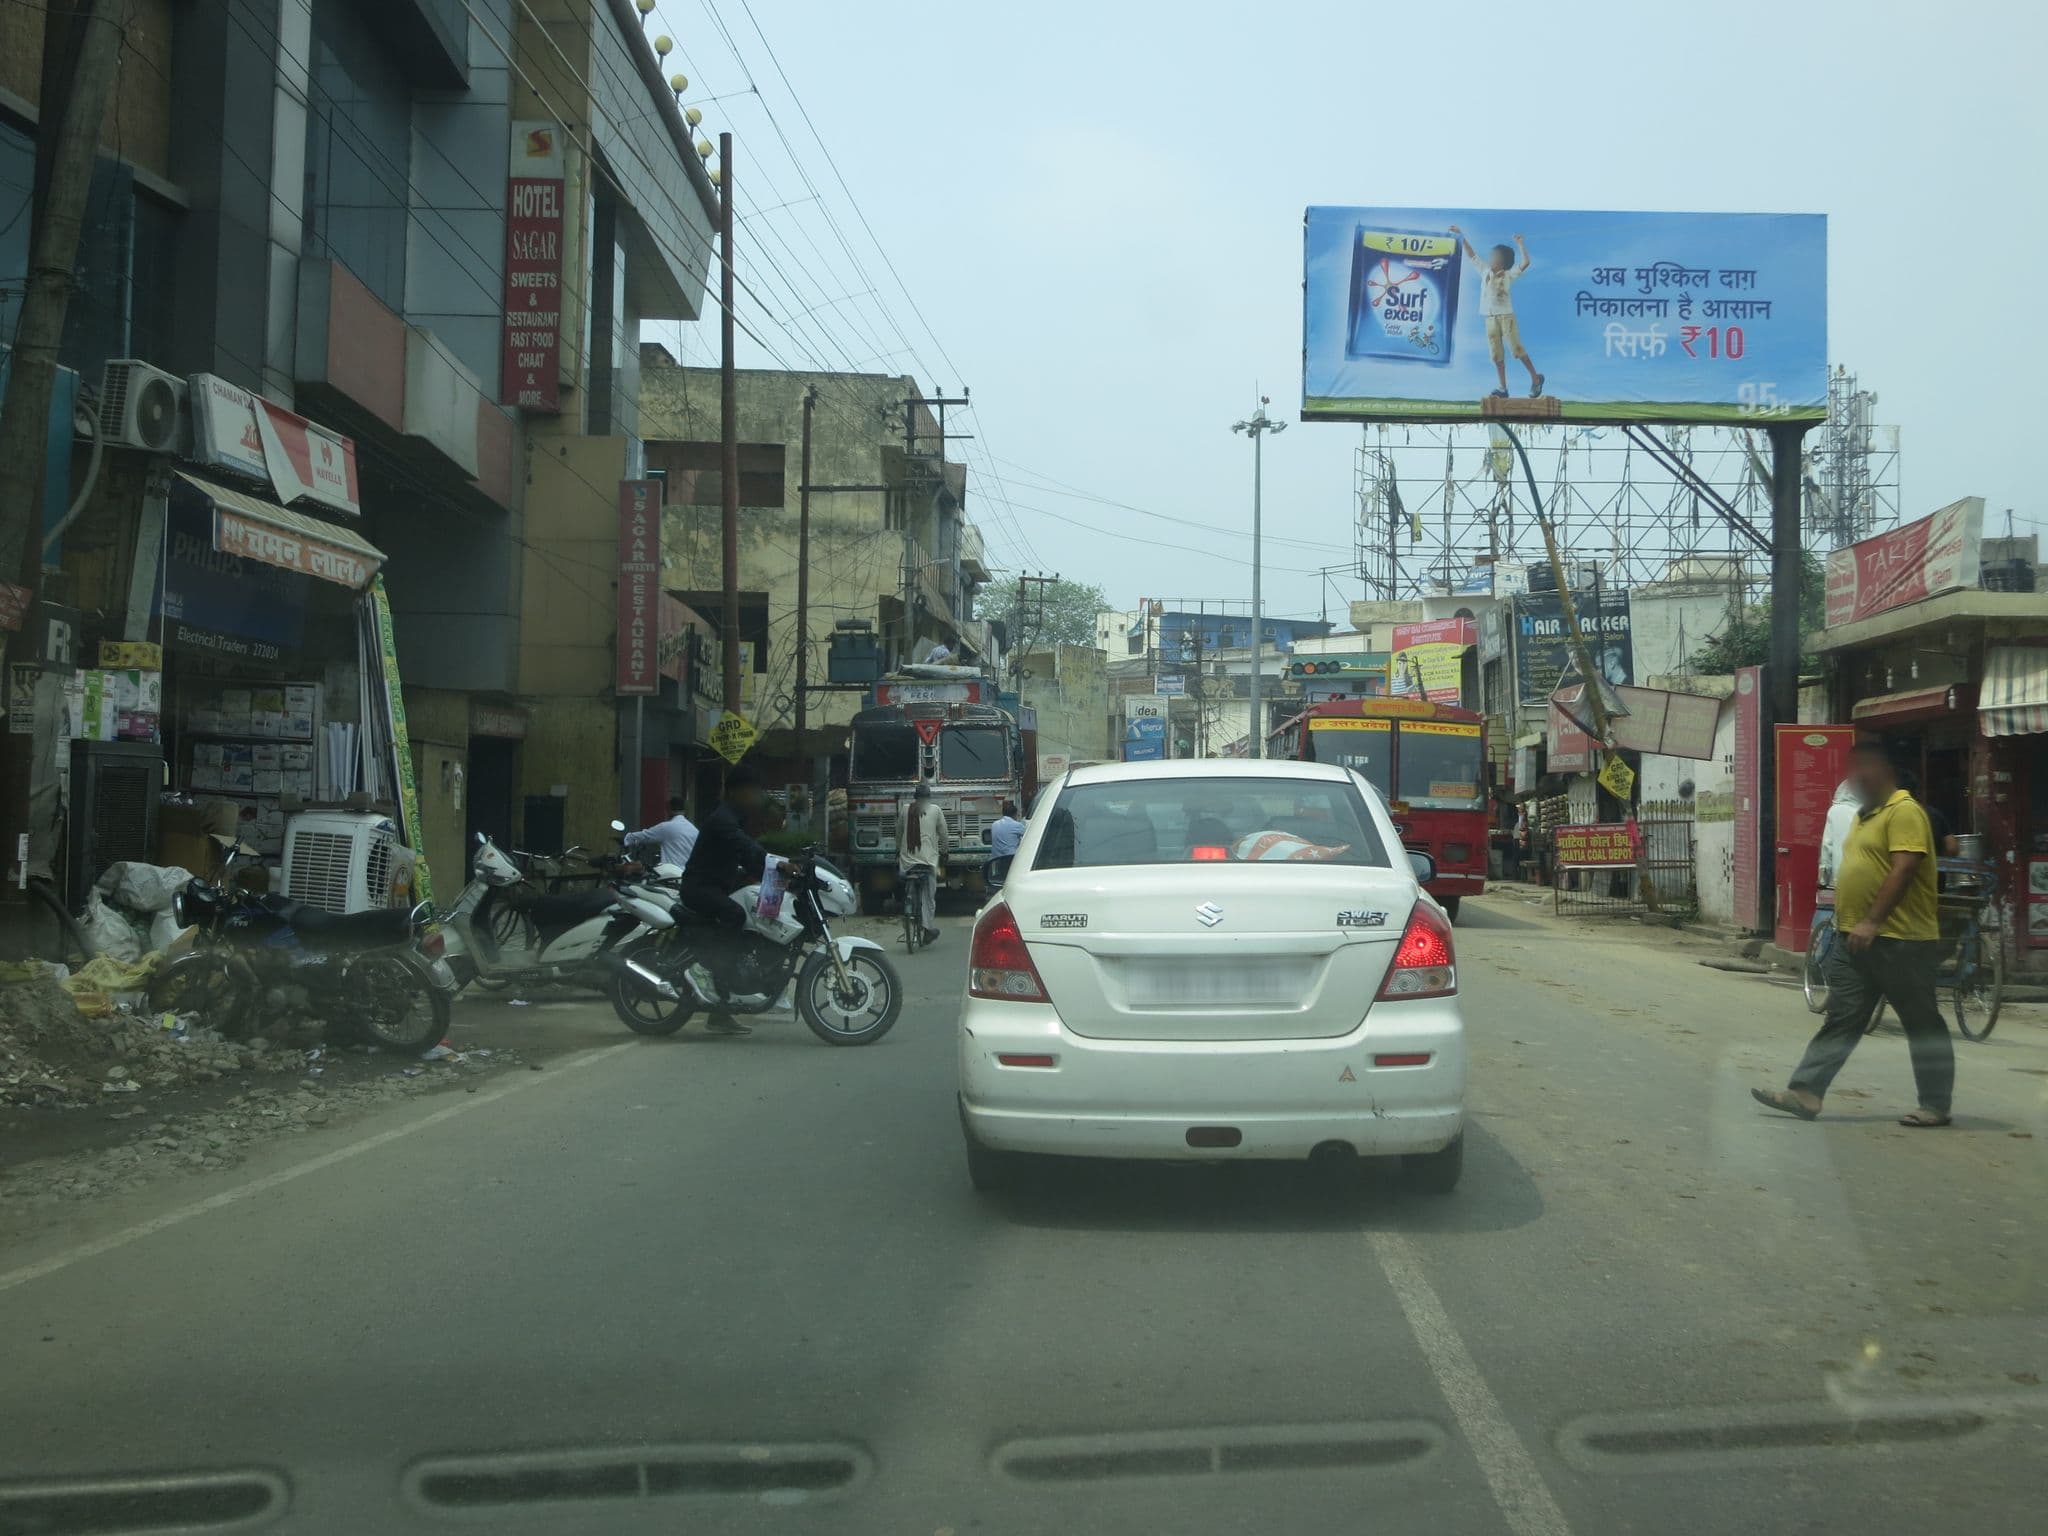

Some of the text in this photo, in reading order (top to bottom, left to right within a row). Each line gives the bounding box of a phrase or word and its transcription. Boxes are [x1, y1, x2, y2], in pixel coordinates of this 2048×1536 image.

[513, 185, 559, 218] HOTEL
[513, 231, 556, 260] SAGAR
[511, 273, 557, 287] SWEETS
[1592, 267, 1627, 287] अब
[1635, 261, 1711, 294] मुश्किल
[529, 293, 538, 306] &
[1386, 286, 1427, 307] Surf
[1575, 290, 1772, 320] निकालना है आसान
[506, 312, 559, 327] RESTAURANT
[1384, 307, 1423, 322] excel
[510, 331, 554, 347] FAST FOOD
[518, 352, 545, 368] CHAAT
[527, 373, 535, 385] &
[519, 391, 542, 405] MORE
[632, 500, 647, 562] SAGAR
[173, 530, 244, 580] PHILIPS
[245, 526, 302, 567] चमन
[630, 574, 647, 681] RESTAURANT
[1521, 617, 1560, 635] HAIR
[176, 626, 217, 649] Electrical
[217, 633, 248, 655] Traders
[1338, 911, 1388, 919] SWIFT
